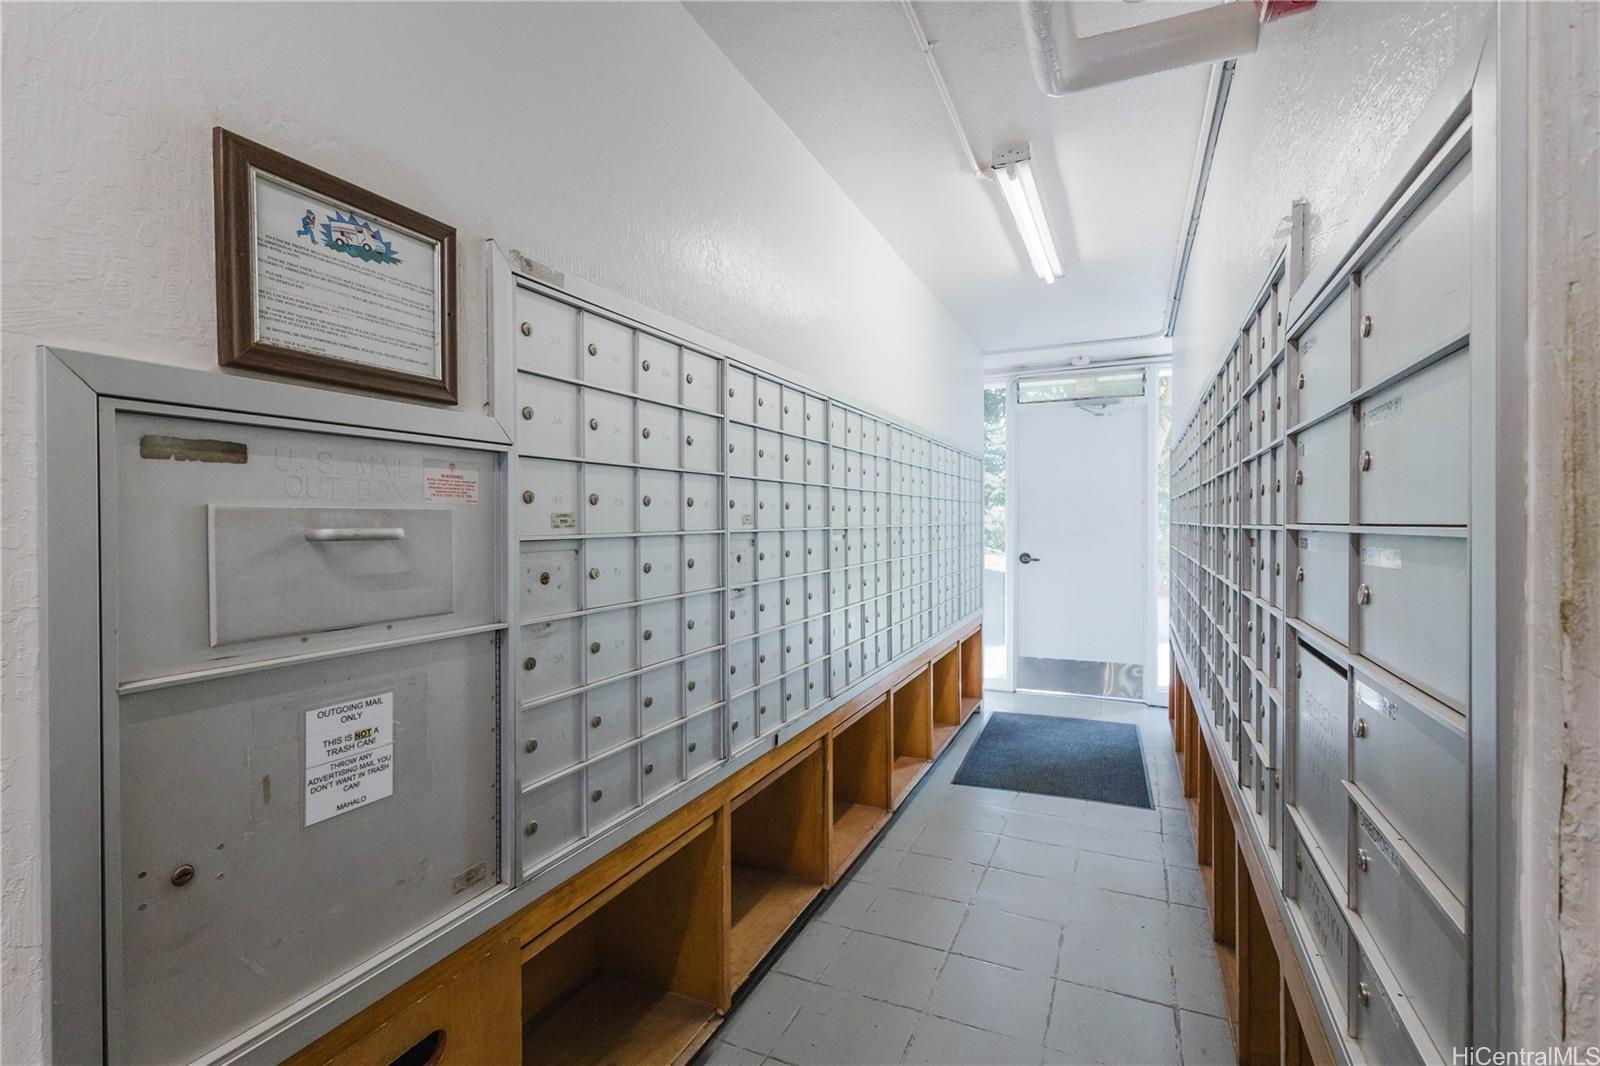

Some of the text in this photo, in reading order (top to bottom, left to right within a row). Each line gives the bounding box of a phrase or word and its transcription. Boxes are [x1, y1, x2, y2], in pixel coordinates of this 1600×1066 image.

[317, 698, 384, 719] OUTGOING MAIL
[340, 712, 363, 723] ONLY
[322, 736, 342, 748] THIS
[354, 728, 372, 741] NOT
[326, 737, 376, 757] TRASH CAN!
[308, 754, 392, 786] ADVERTISING MAIL YOU
[330, 752, 373, 770] THROW ANY
[310, 782, 333, 794] DON'T
[336, 775, 356, 786] WANT
[368, 764, 389, 775] TRASH
[336, 795, 367, 811] MAHALO
